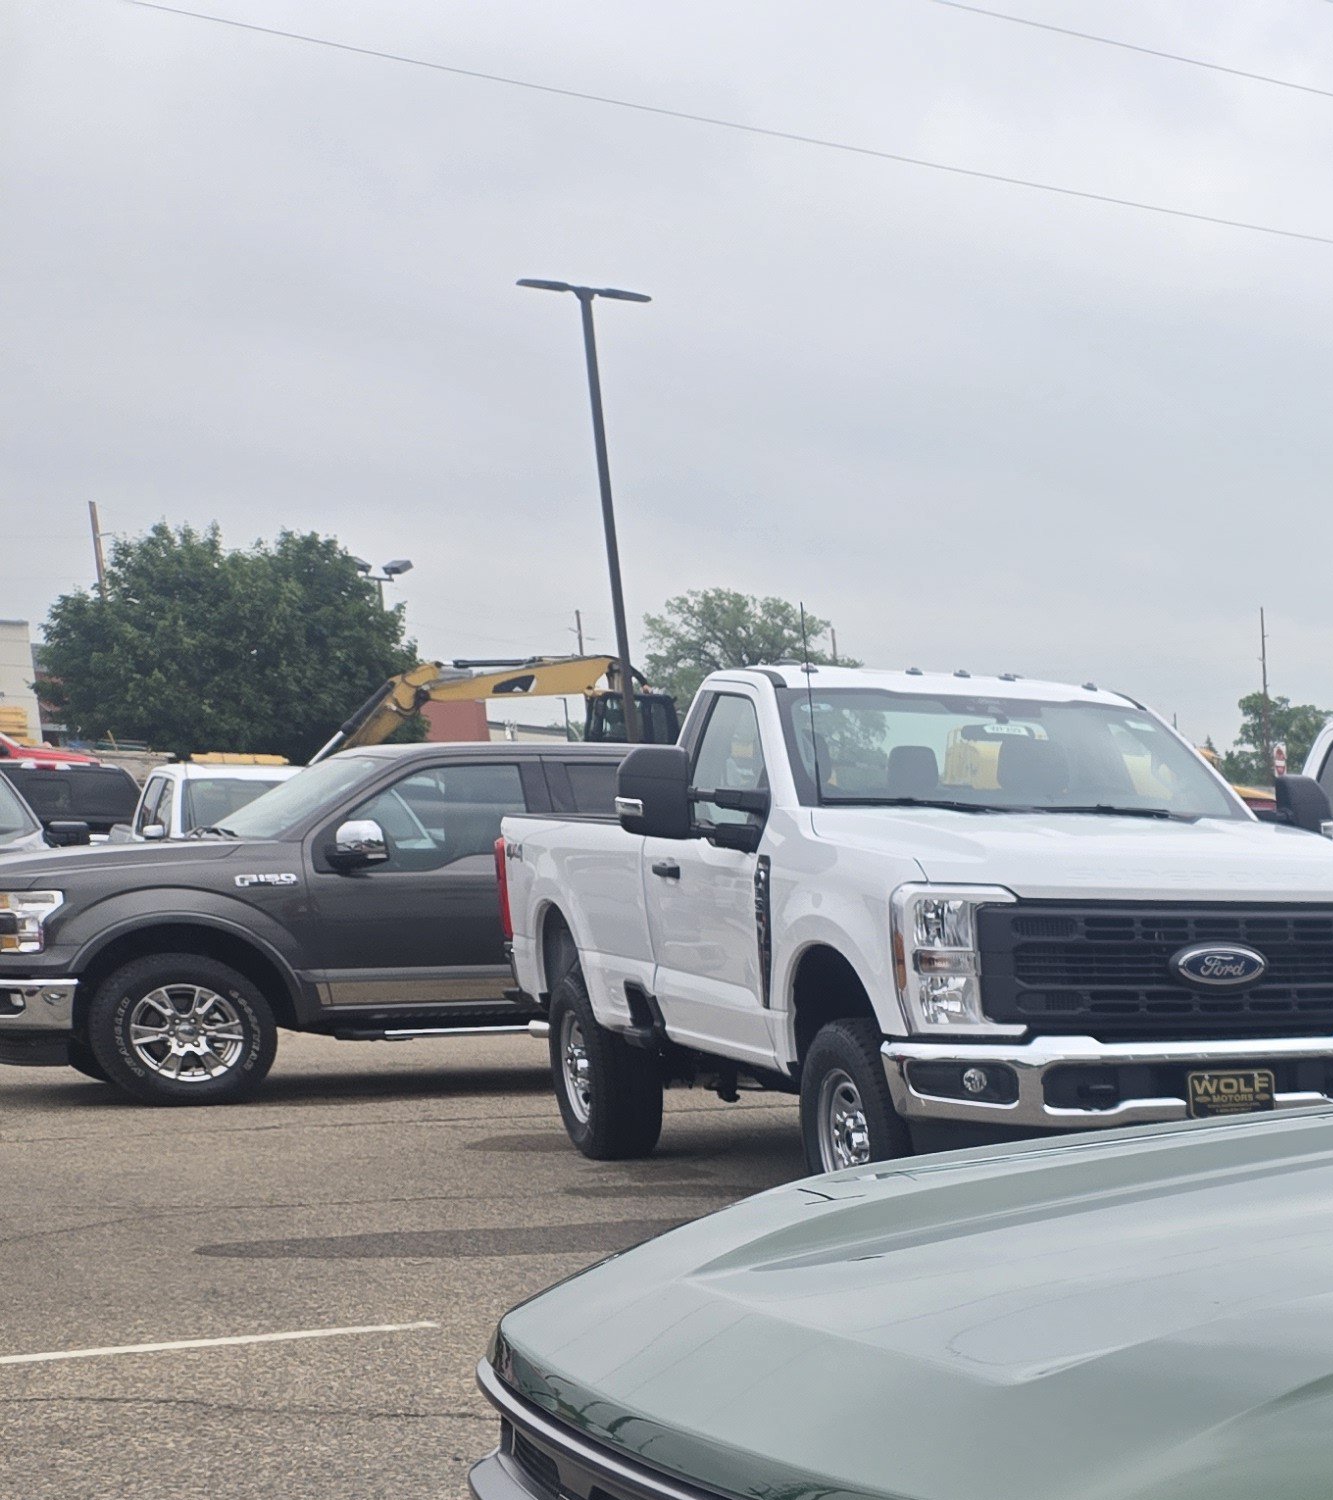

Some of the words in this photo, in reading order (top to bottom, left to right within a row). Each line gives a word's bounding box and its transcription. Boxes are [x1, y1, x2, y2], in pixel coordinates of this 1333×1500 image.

[1200, 955, 1246, 976] Ford
[1193, 1074, 1269, 1095] WOLF
[1212, 1093, 1254, 1103] MOTORS
